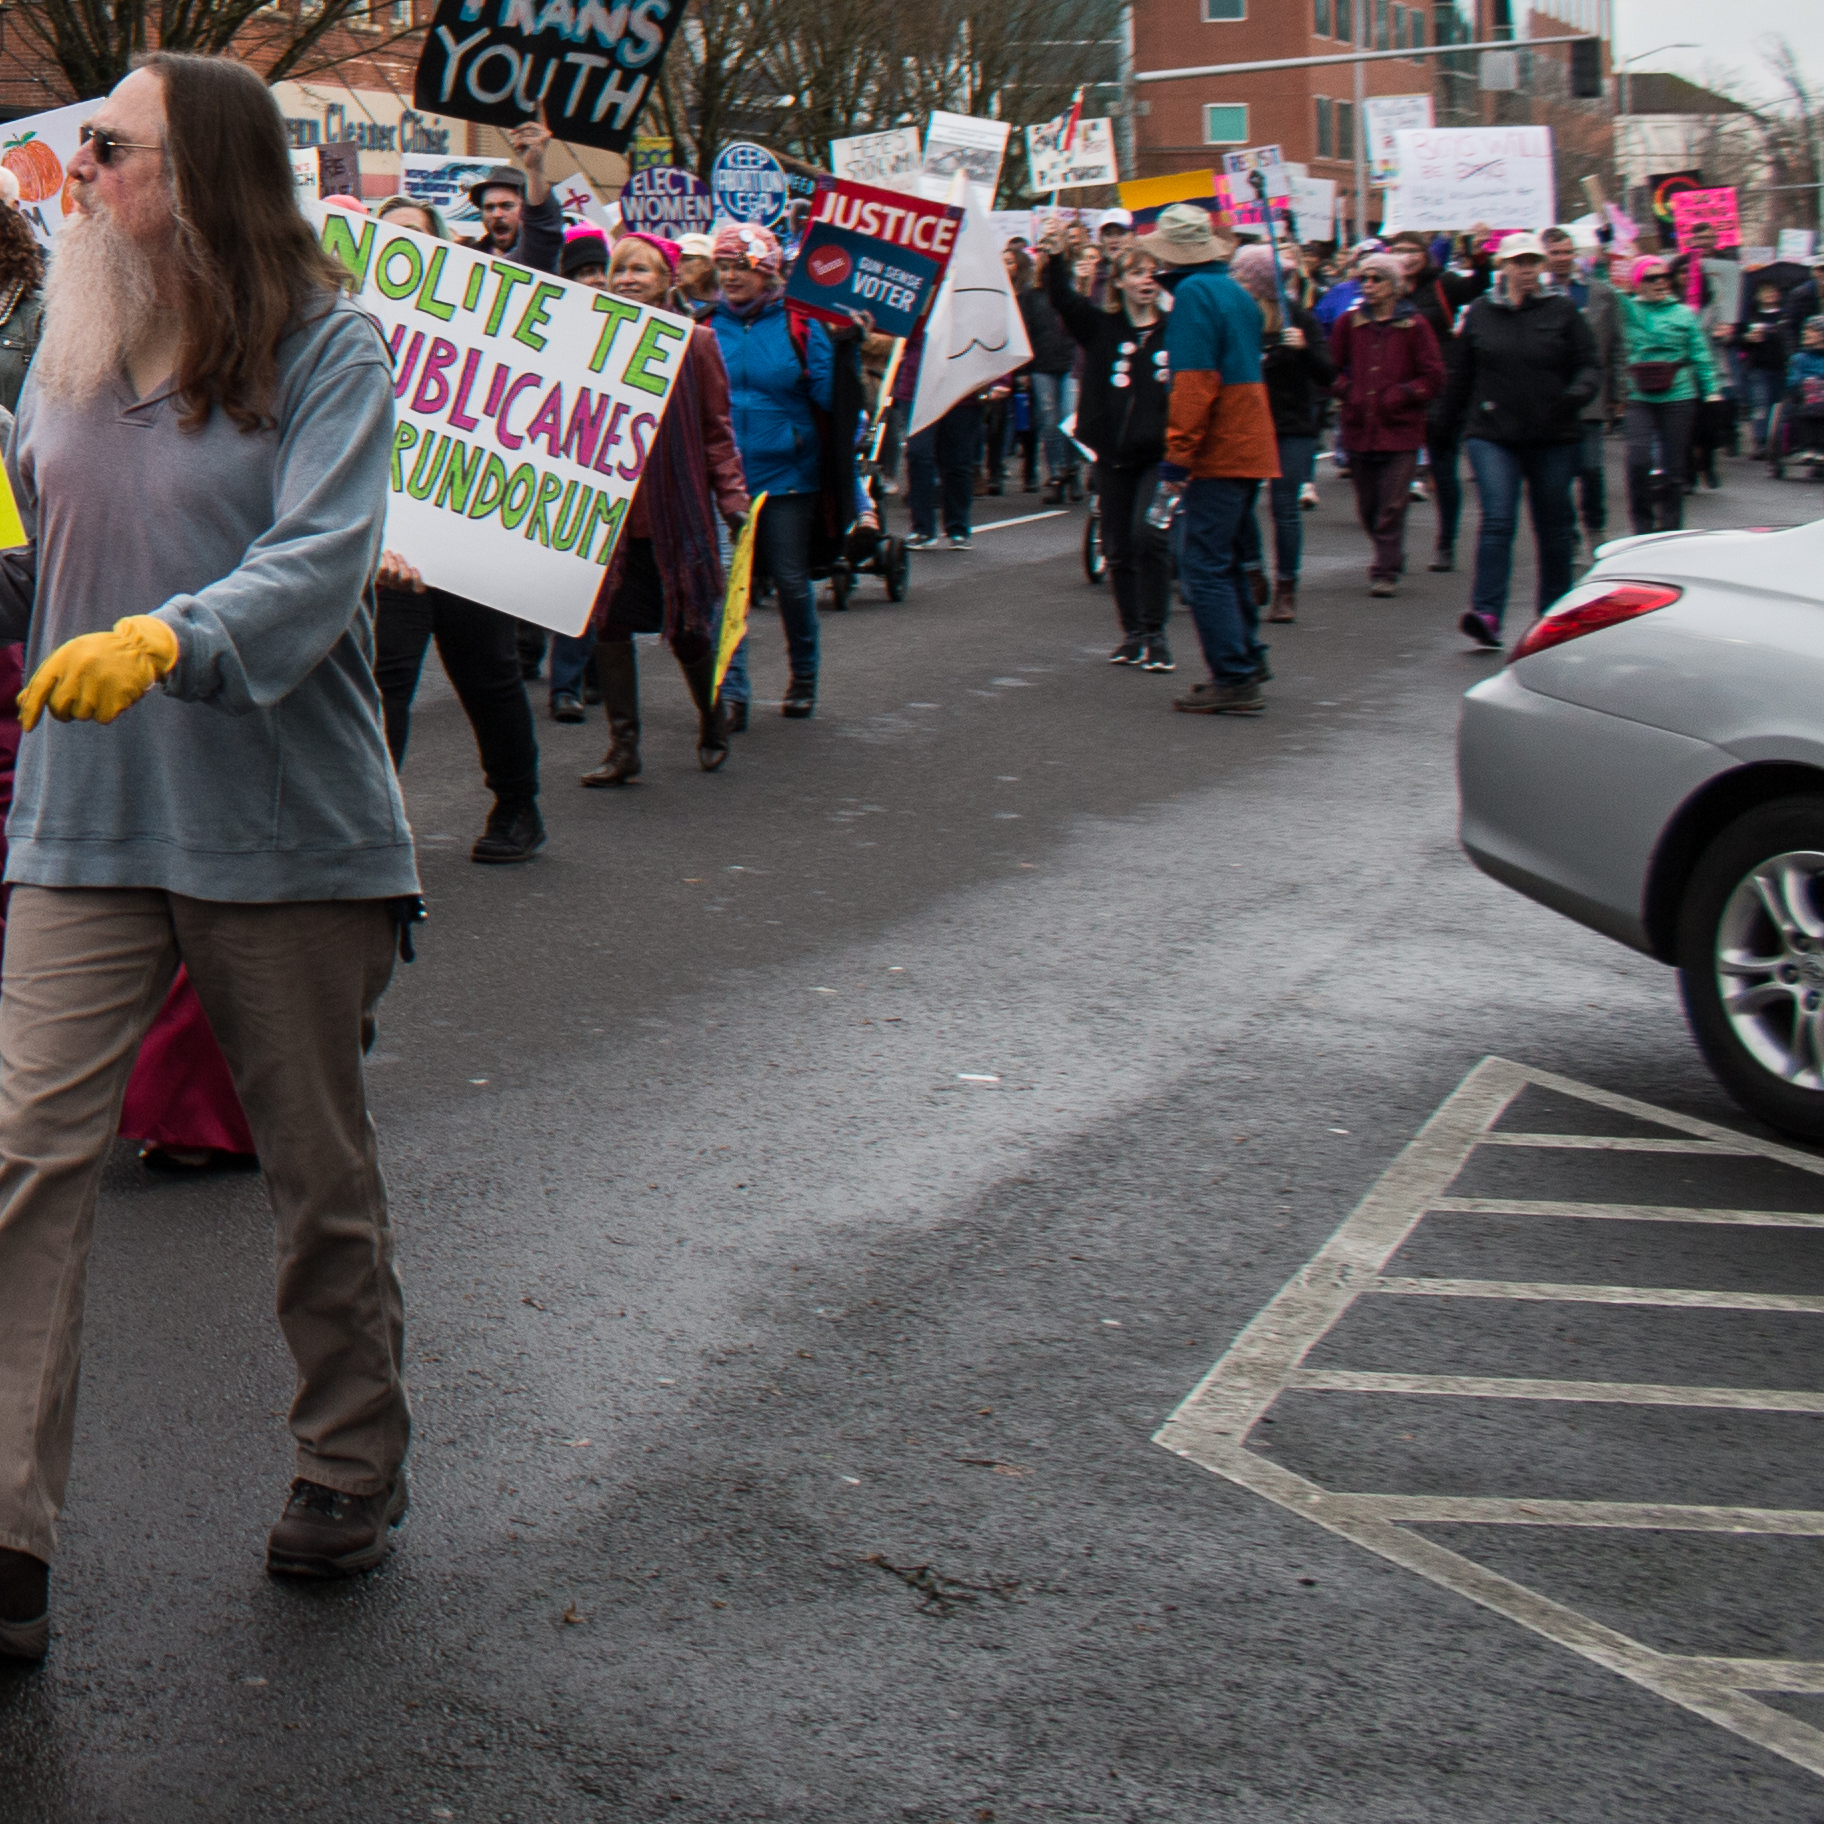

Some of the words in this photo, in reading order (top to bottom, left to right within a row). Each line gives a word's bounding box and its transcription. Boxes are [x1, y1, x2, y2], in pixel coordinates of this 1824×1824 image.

[435, 24, 650, 132] YOUTH
[630, 167, 700, 196] ELECT
[724, 148, 770, 169] KEEP
[620, 195, 712, 221] WOMEN
[811, 192, 958, 254] JUSTICE
[851, 271, 916, 313] VOTER
[884, 266, 924, 290] SENSE
[321, 213, 566, 354] NOLITE
[588, 293, 685, 397] TE
[388, 322, 658, 483] UBLICANES
[391, 419, 631, 568] RUNDORUM
